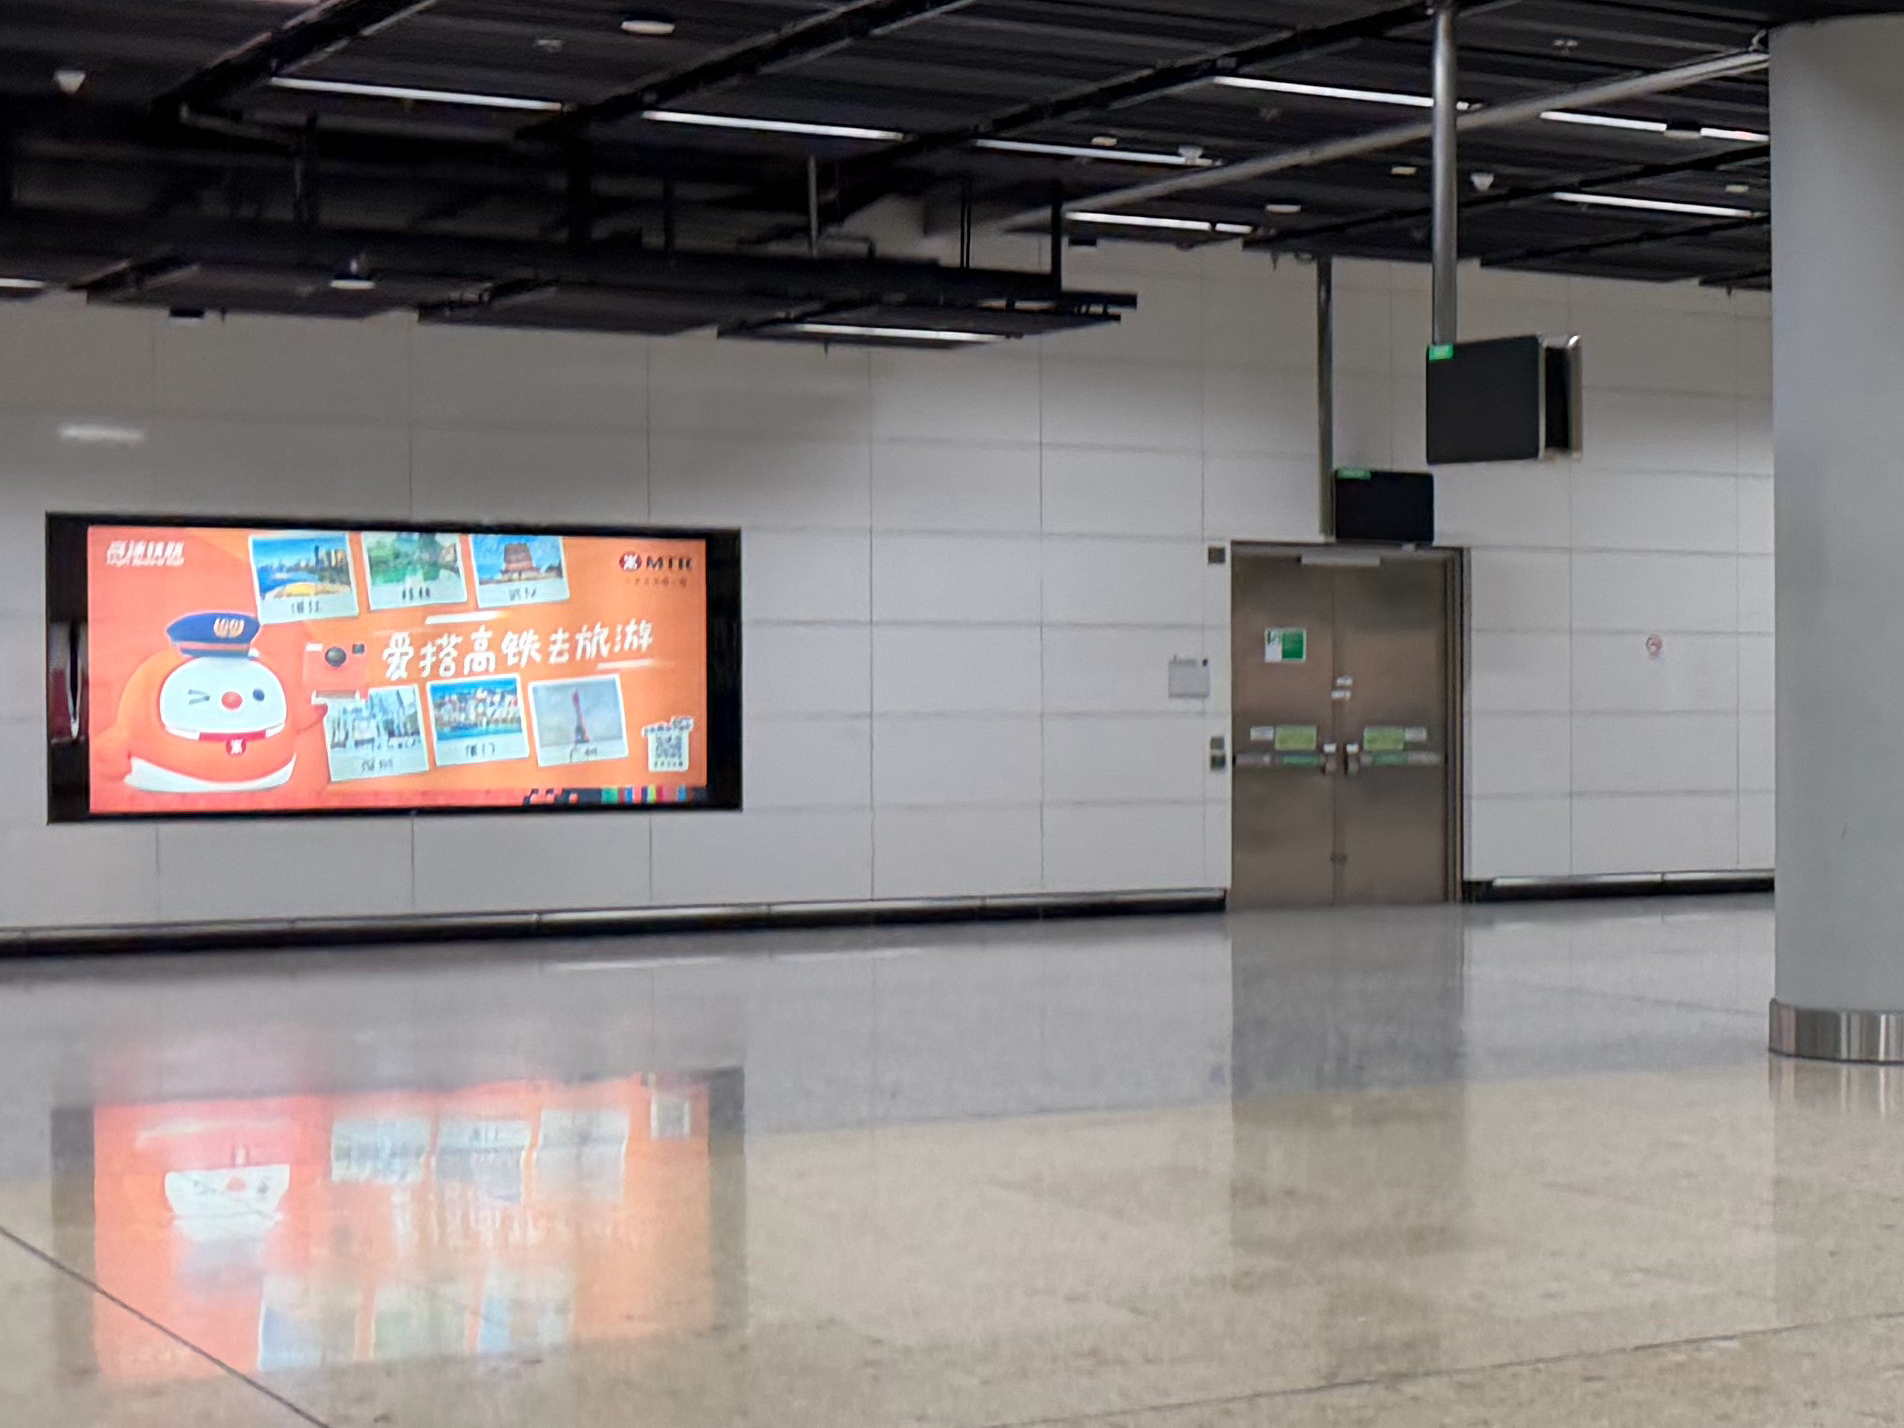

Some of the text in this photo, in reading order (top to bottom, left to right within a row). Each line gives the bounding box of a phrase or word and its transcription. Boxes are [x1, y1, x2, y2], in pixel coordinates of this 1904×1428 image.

[382, 618, 653, 680] 爱搭高铁去旅游
